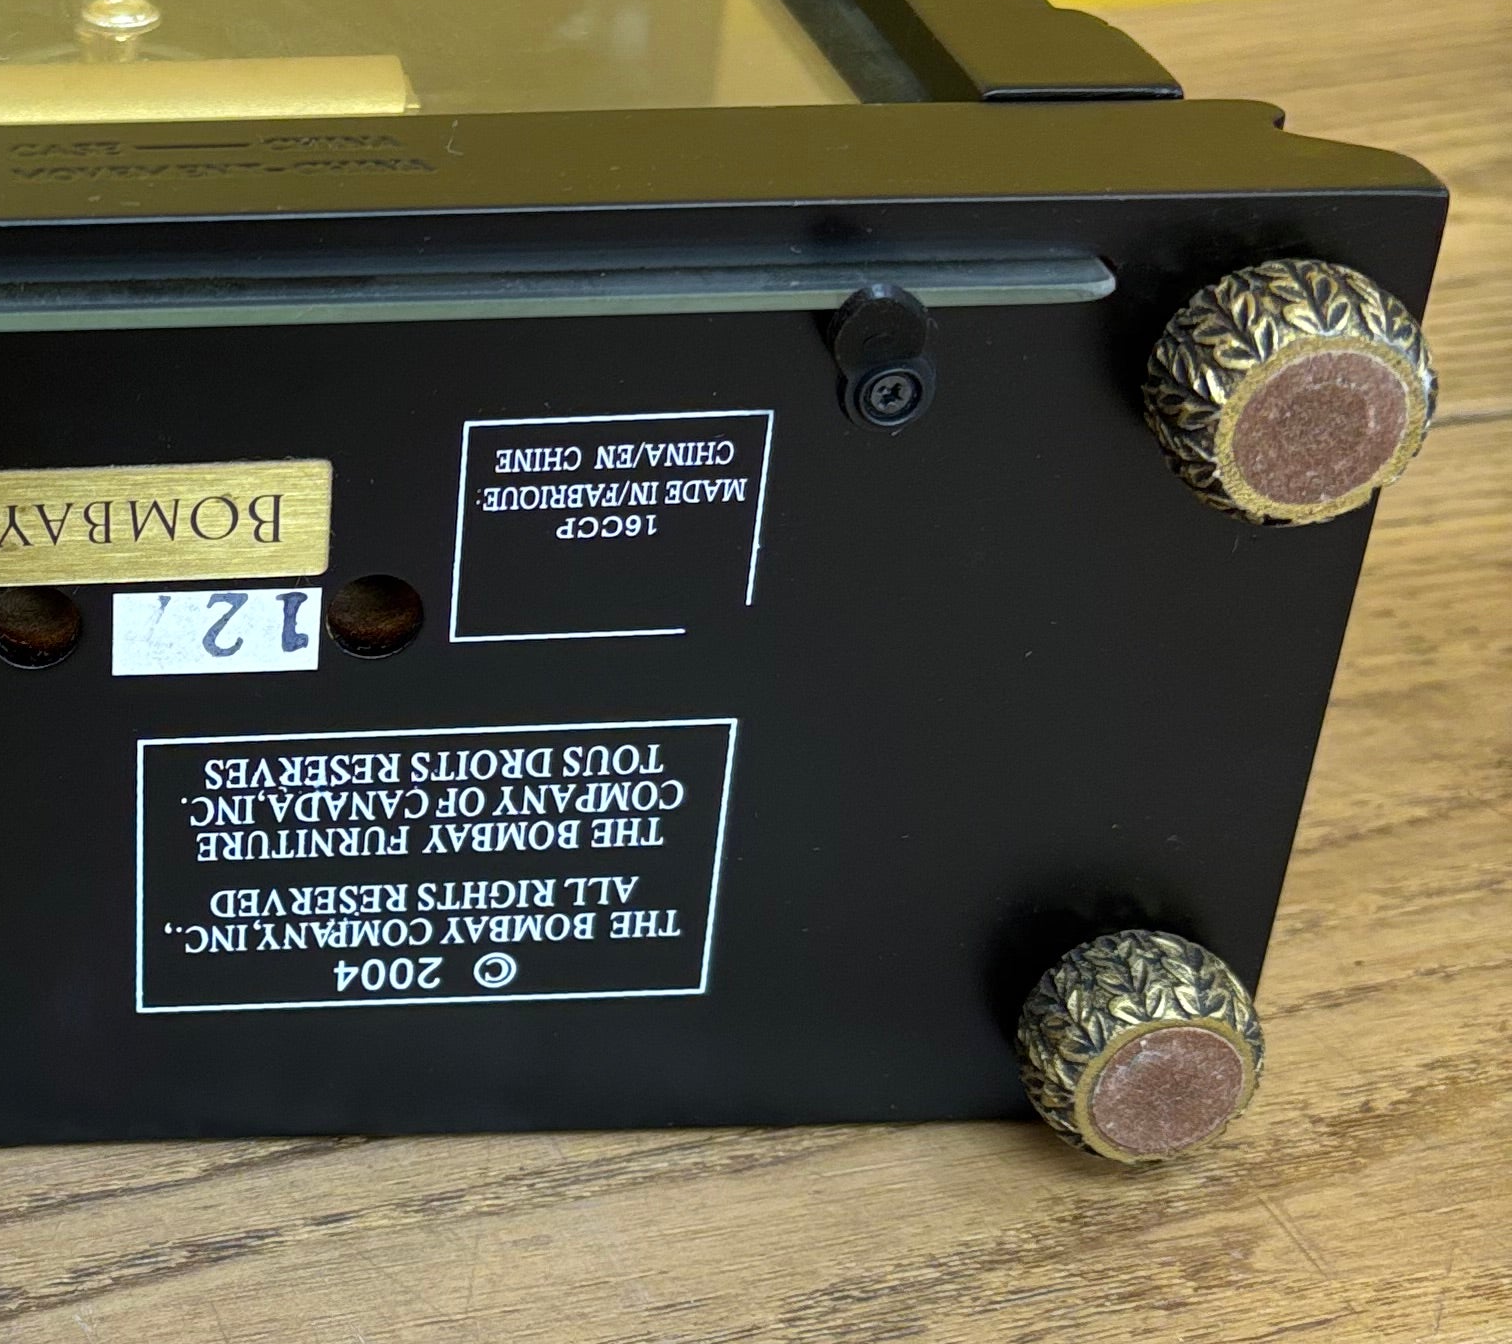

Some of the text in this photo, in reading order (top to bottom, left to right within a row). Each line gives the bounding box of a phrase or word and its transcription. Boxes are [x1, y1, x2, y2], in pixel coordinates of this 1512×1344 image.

[495, 441, 734, 473] CHINA/EN CHINE
[665, 479, 748, 504] MADE
[556, 515, 658, 539] 16CCP
[206, 744, 664, 790] TOUS DROITS RESERVES
[437, 787, 485, 817] OF
[493, 781, 684, 816] COMPANY
[197, 817, 664, 861] THE BOMBAY FURNITURE
[210, 876, 639, 918] ALL RIGHTS RESERVED
[441, 912, 595, 944] BOMBAY
[610, 910, 680, 939] THE
[334, 957, 443, 991] 2004
